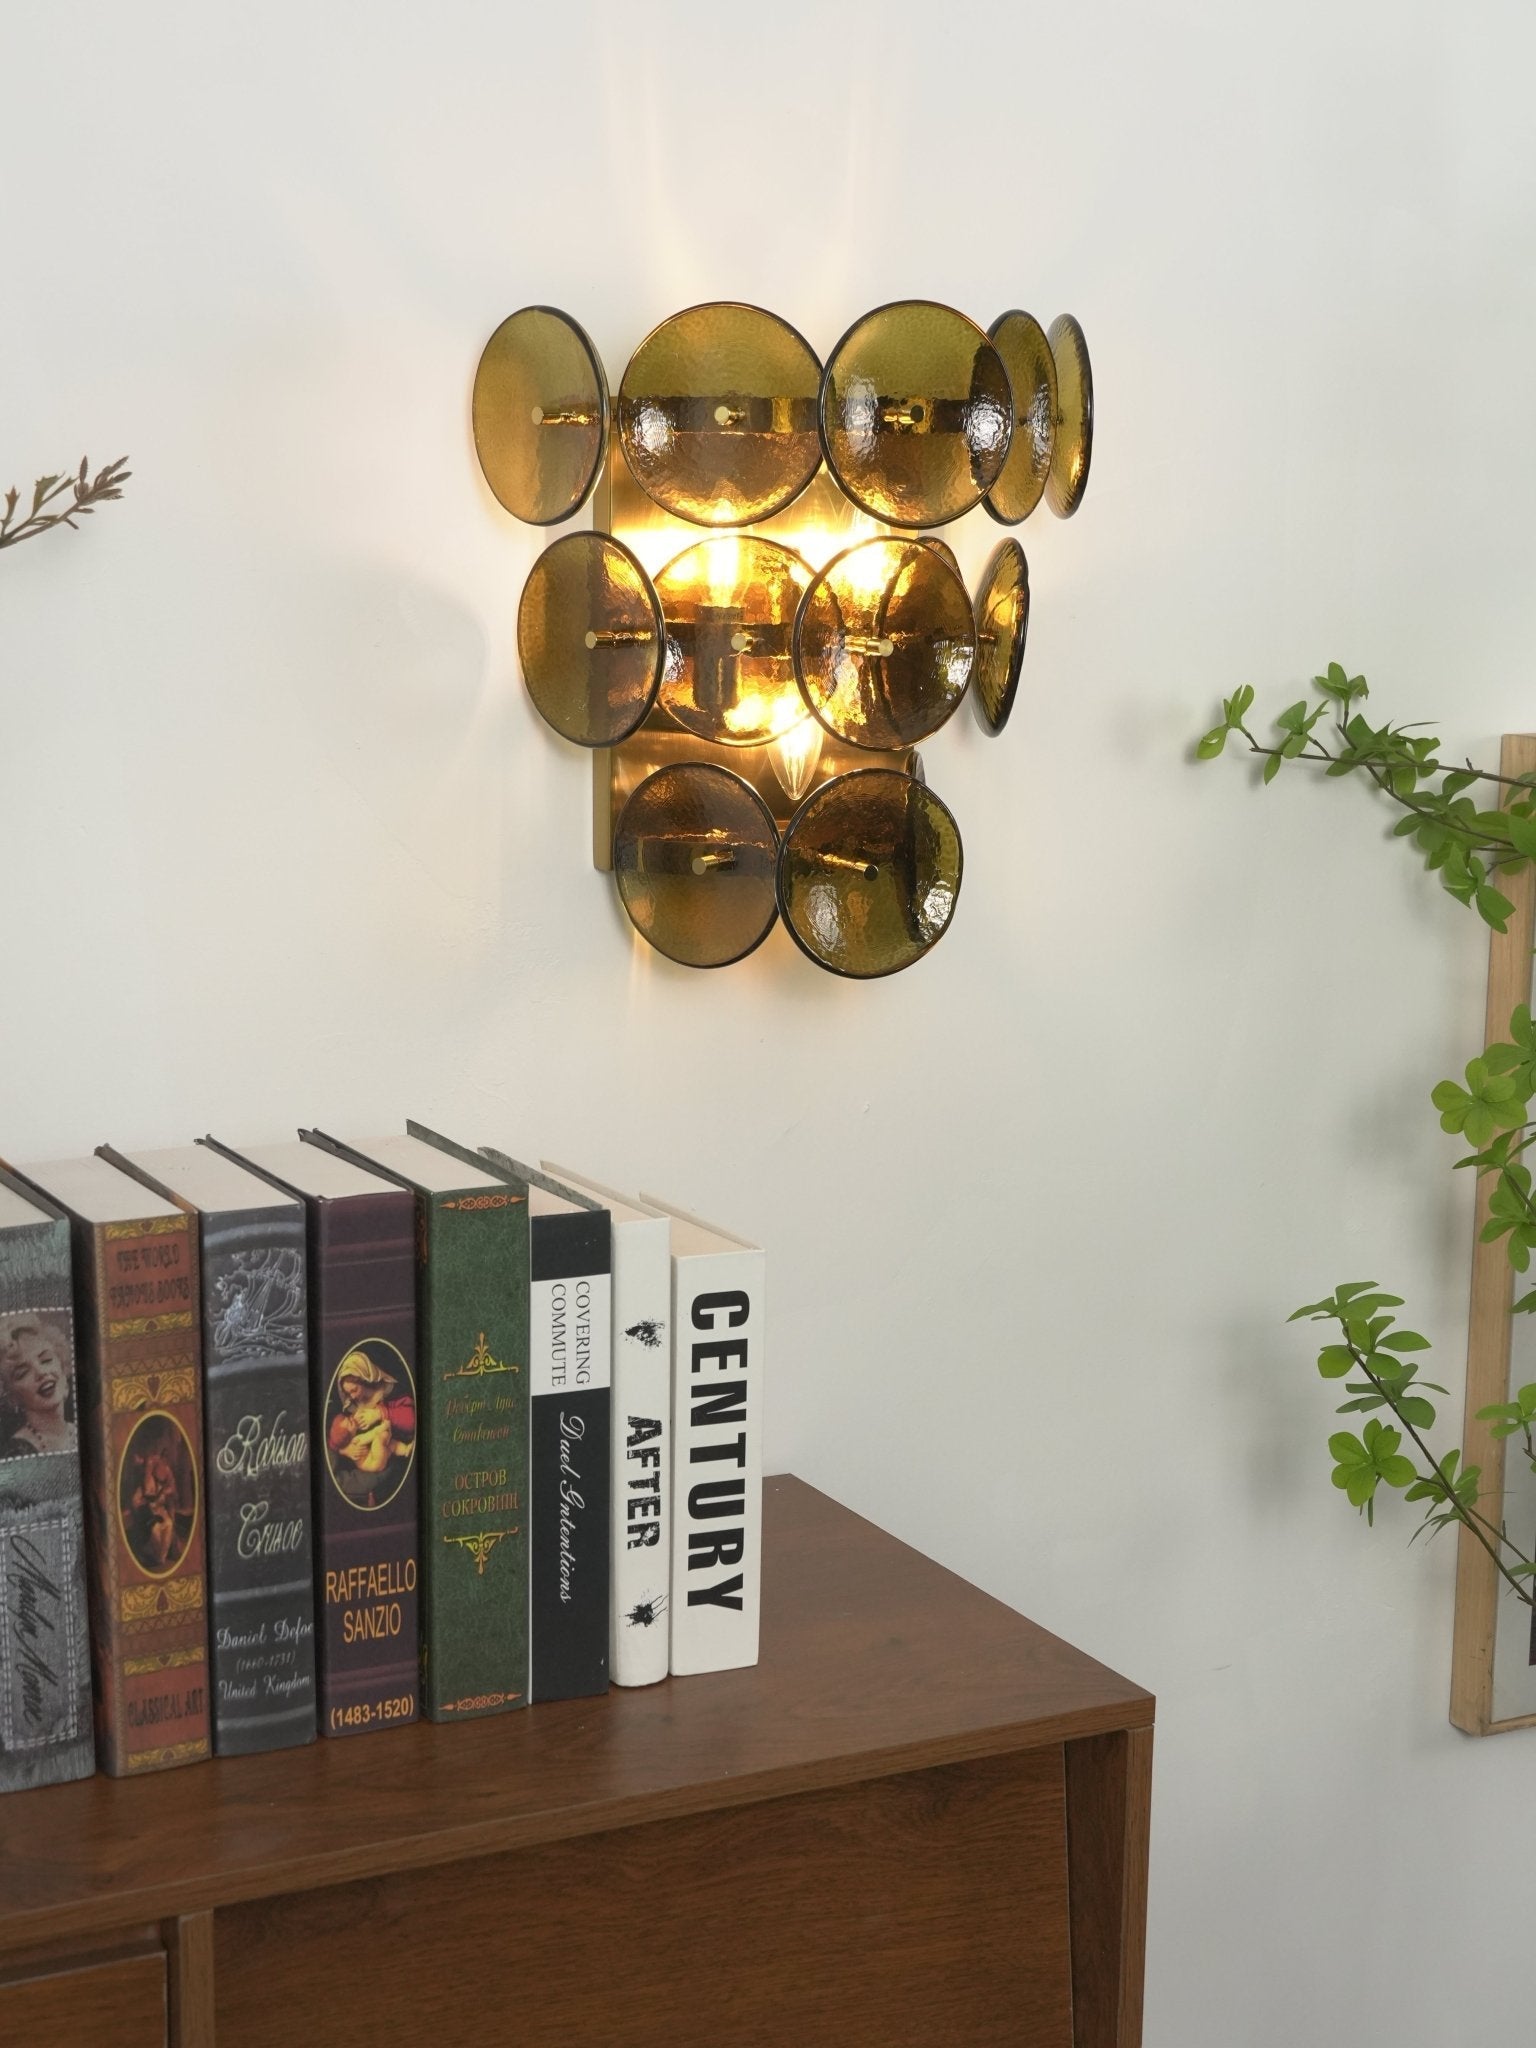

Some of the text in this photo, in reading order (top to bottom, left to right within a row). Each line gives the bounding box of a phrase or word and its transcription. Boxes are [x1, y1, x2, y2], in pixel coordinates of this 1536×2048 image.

[551, 1283, 567, 1387] COMMUTE
[576, 1281, 591, 1385] COVERING
[687, 1290, 751, 1612] CENTURY
[454, 1468, 508, 1491] ОСТРОВ
[626, 1415, 663, 1551] AFTER
[237, 1500, 303, 1559] Crusoe
[559, 1411, 586, 1604] Duel Intentions
[325, 1558, 417, 1604] RAFFAELLO
[216, 1616, 314, 1649] Daniel Defoe
[343, 1602, 401, 1644] SANZIO
[218, 1671, 312, 1702] United Kingdom
[330, 1694, 415, 1730] (1483-1520)
